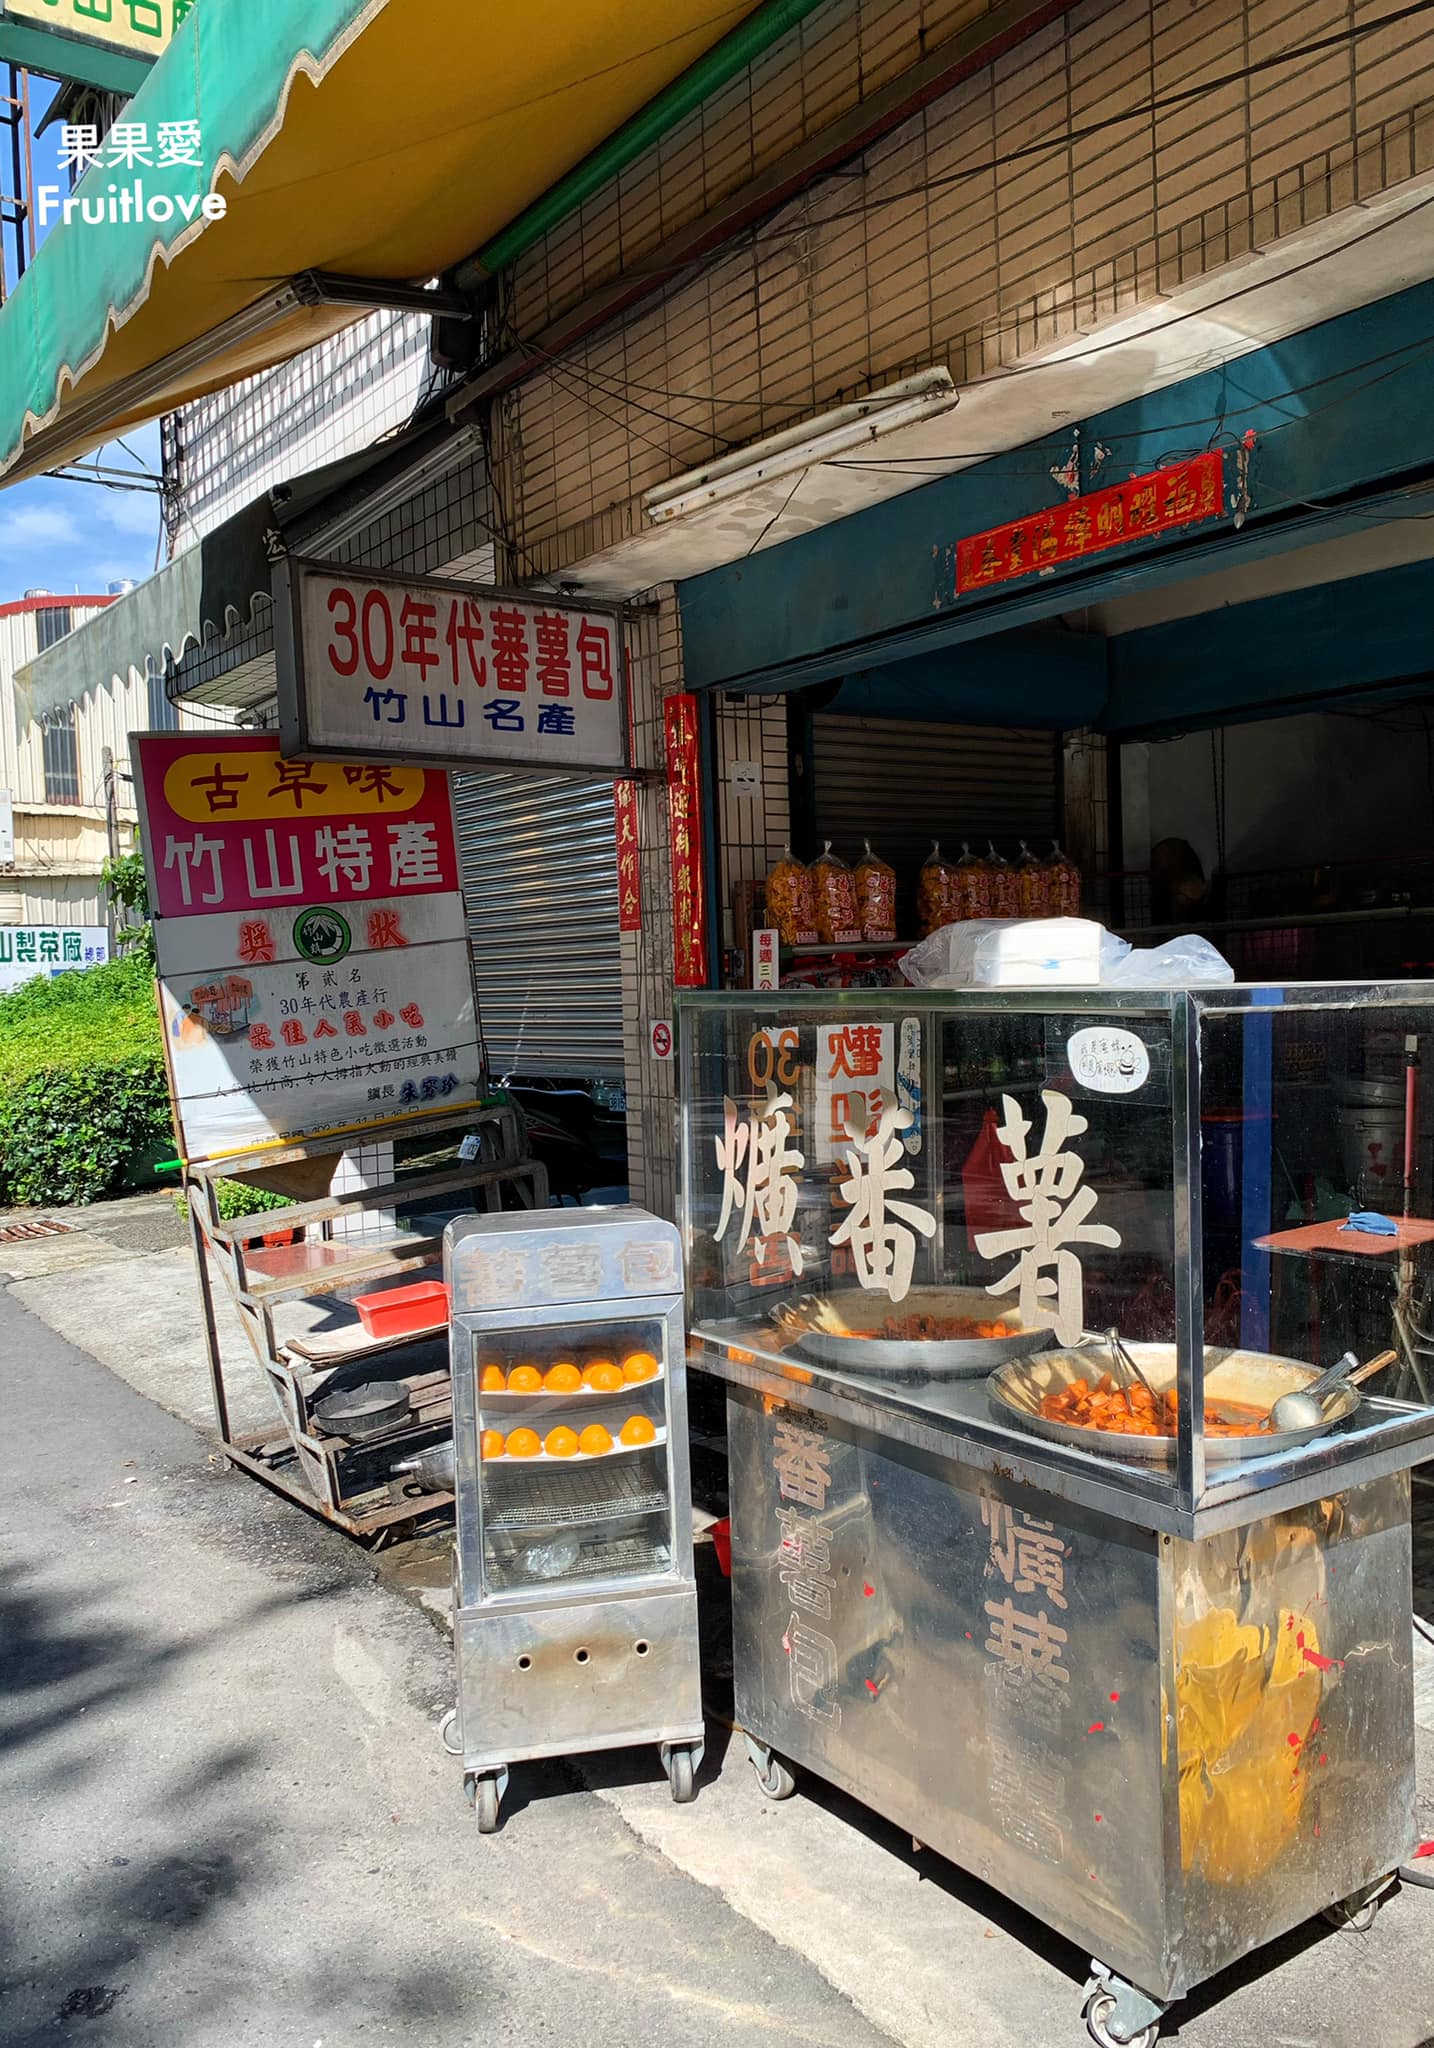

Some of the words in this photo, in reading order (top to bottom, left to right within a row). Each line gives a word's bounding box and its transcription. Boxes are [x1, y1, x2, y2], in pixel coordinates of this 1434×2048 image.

[327, 587, 613, 700] 30年代蕃薯包
[364, 686, 576, 736] 竹山名產
[190, 760, 405, 813] 古早味
[164, 821, 443, 906] 竹山特產
[295, 968, 362, 991] 第貳名
[248, 1002, 425, 1050] 最佳人氣小吃
